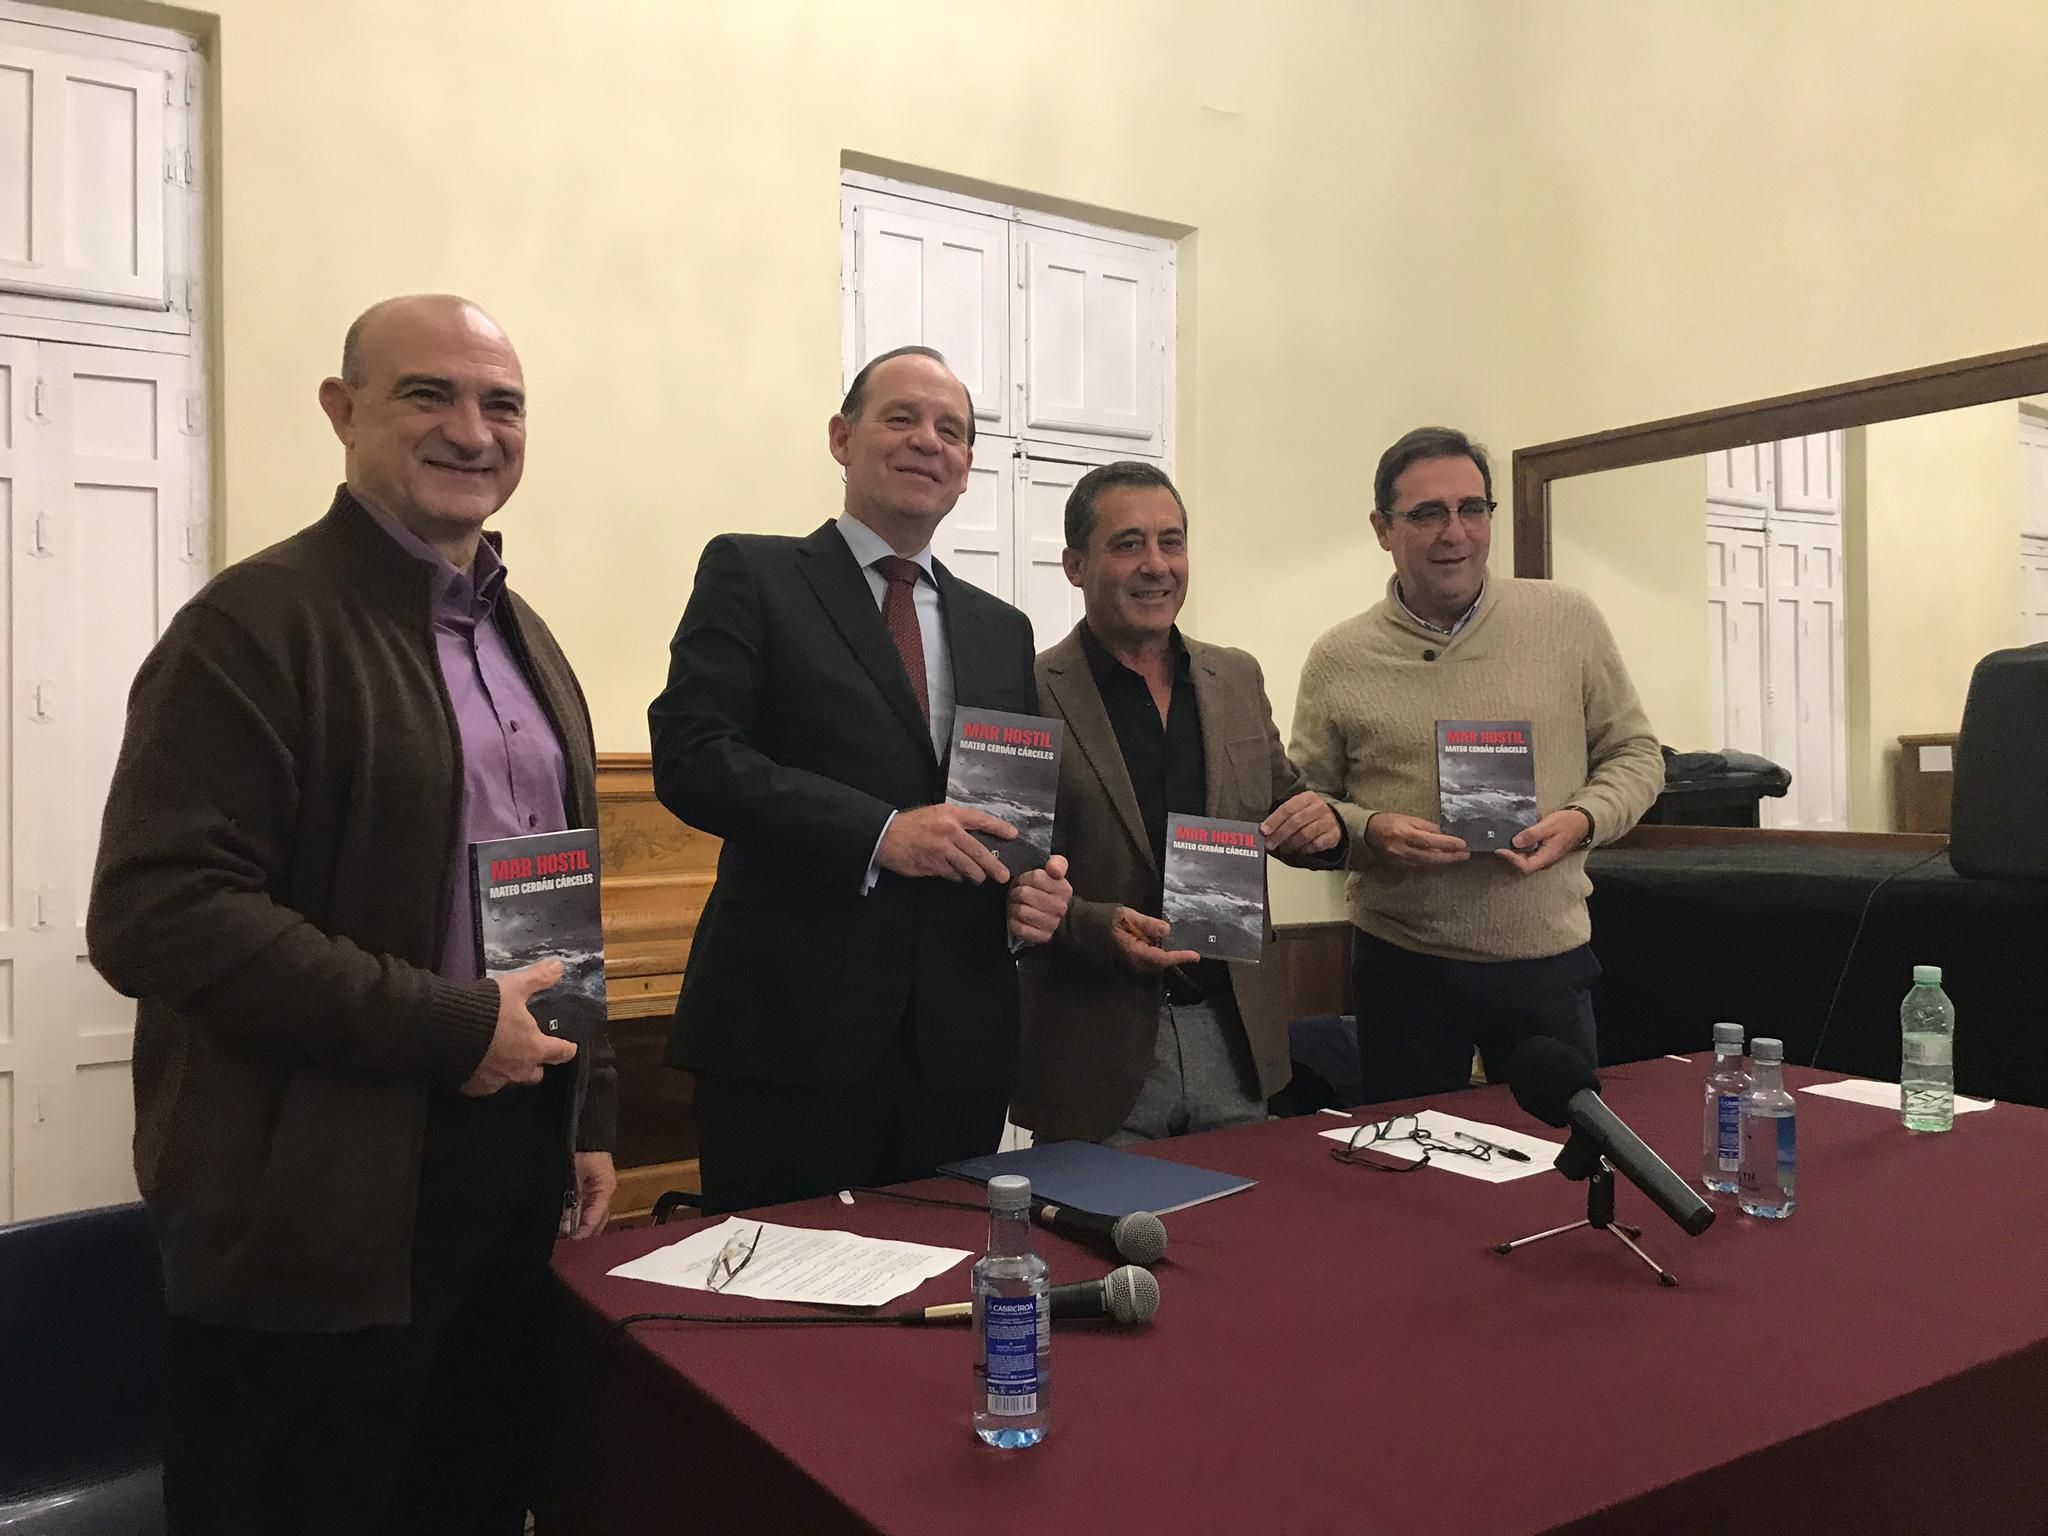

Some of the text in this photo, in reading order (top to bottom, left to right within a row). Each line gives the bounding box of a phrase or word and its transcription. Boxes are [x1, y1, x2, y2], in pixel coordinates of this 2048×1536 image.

[964, 722, 1052, 747] MAR HOSTIL
[1447, 730, 1524, 743] MAR HOSTIL
[960, 740, 1054, 759] MATEO CERDÁN CÁRCELES
[1445, 743, 1528, 754] MATEO CERDÁN CÁRCELES
[1176, 826, 1256, 846] MAR HOSTIL
[1173, 841, 1259, 858] MATEO CERDÁN CÁRCELES
[491, 849, 589, 881] MAR HOSTIL
[489, 873, 593, 898] MATEO CERDÁN CÁRCELES
